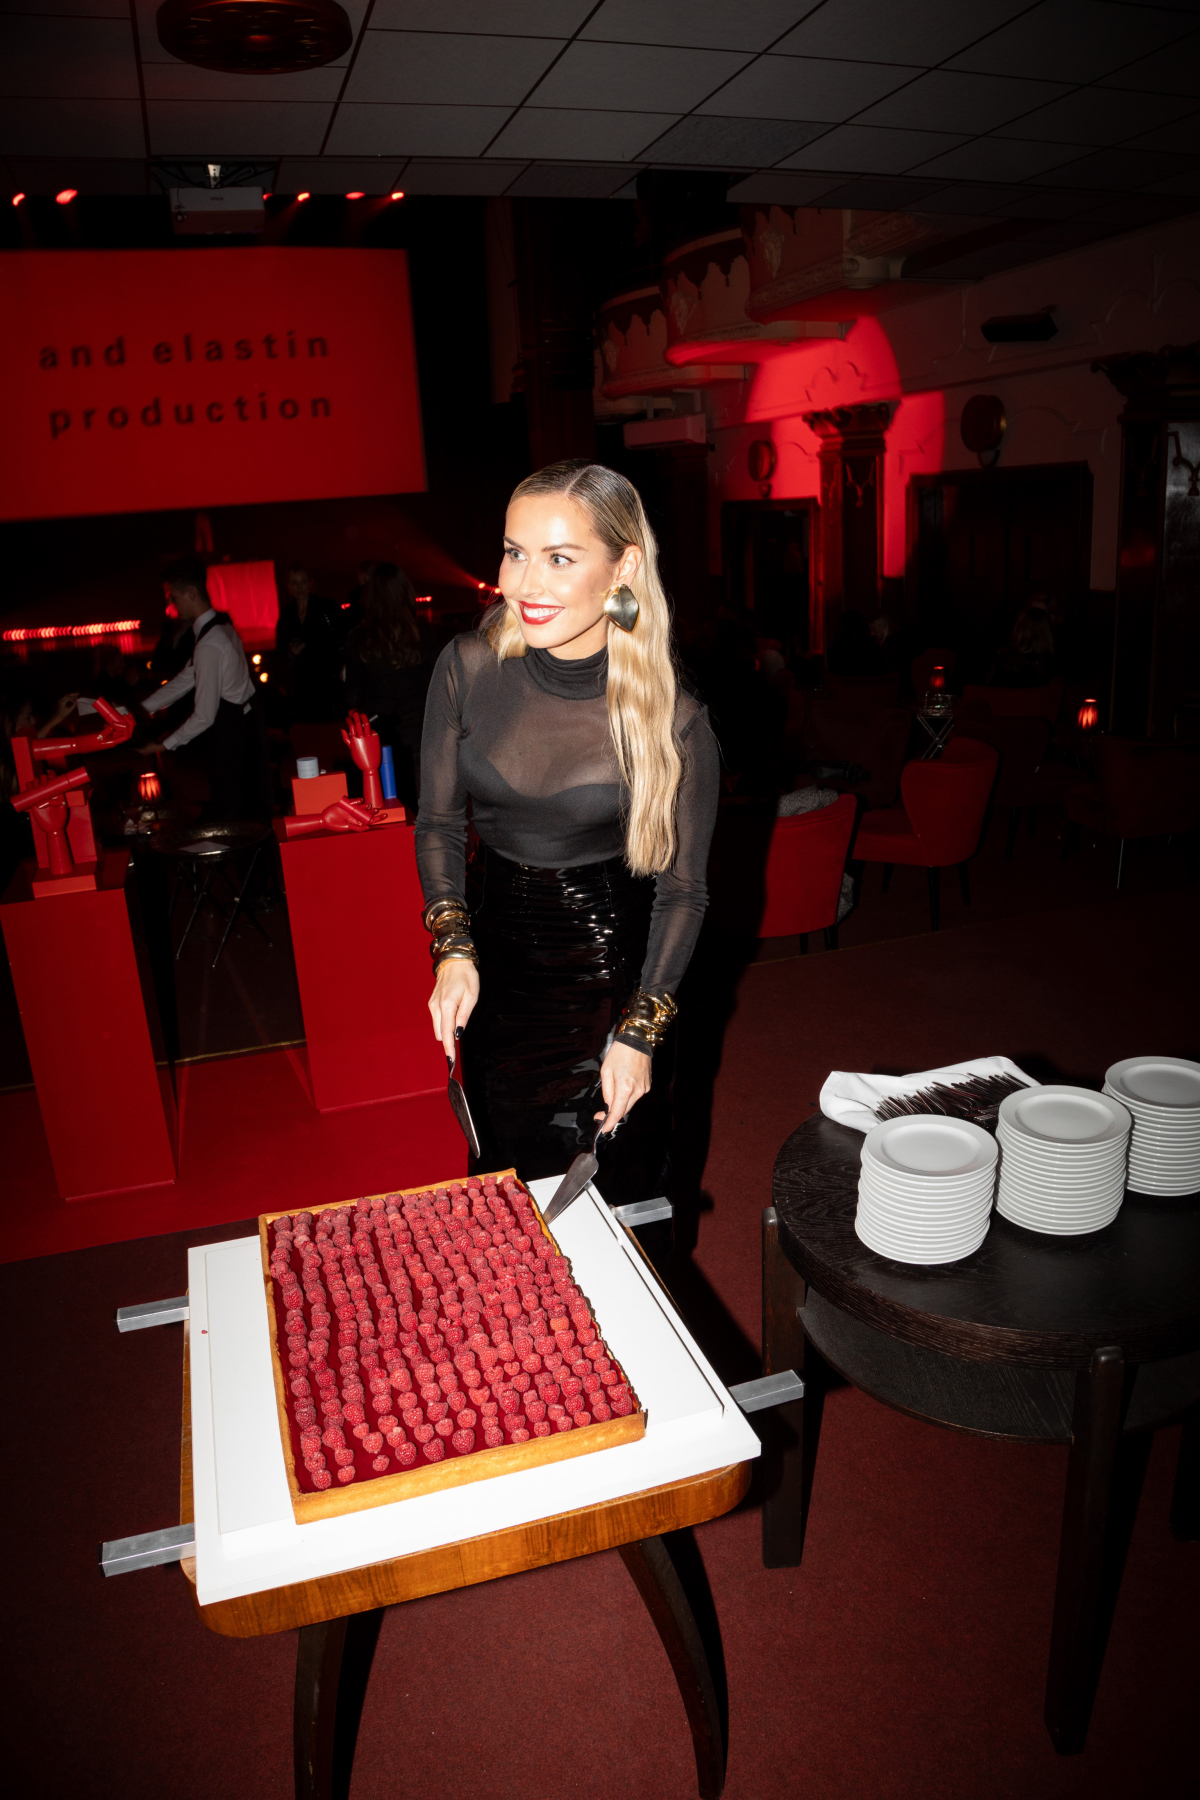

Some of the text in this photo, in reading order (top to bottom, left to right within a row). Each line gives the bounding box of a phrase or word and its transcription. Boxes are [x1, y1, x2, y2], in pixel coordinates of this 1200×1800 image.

[38, 330, 329, 371] and elastin
[48, 391, 332, 440] production
